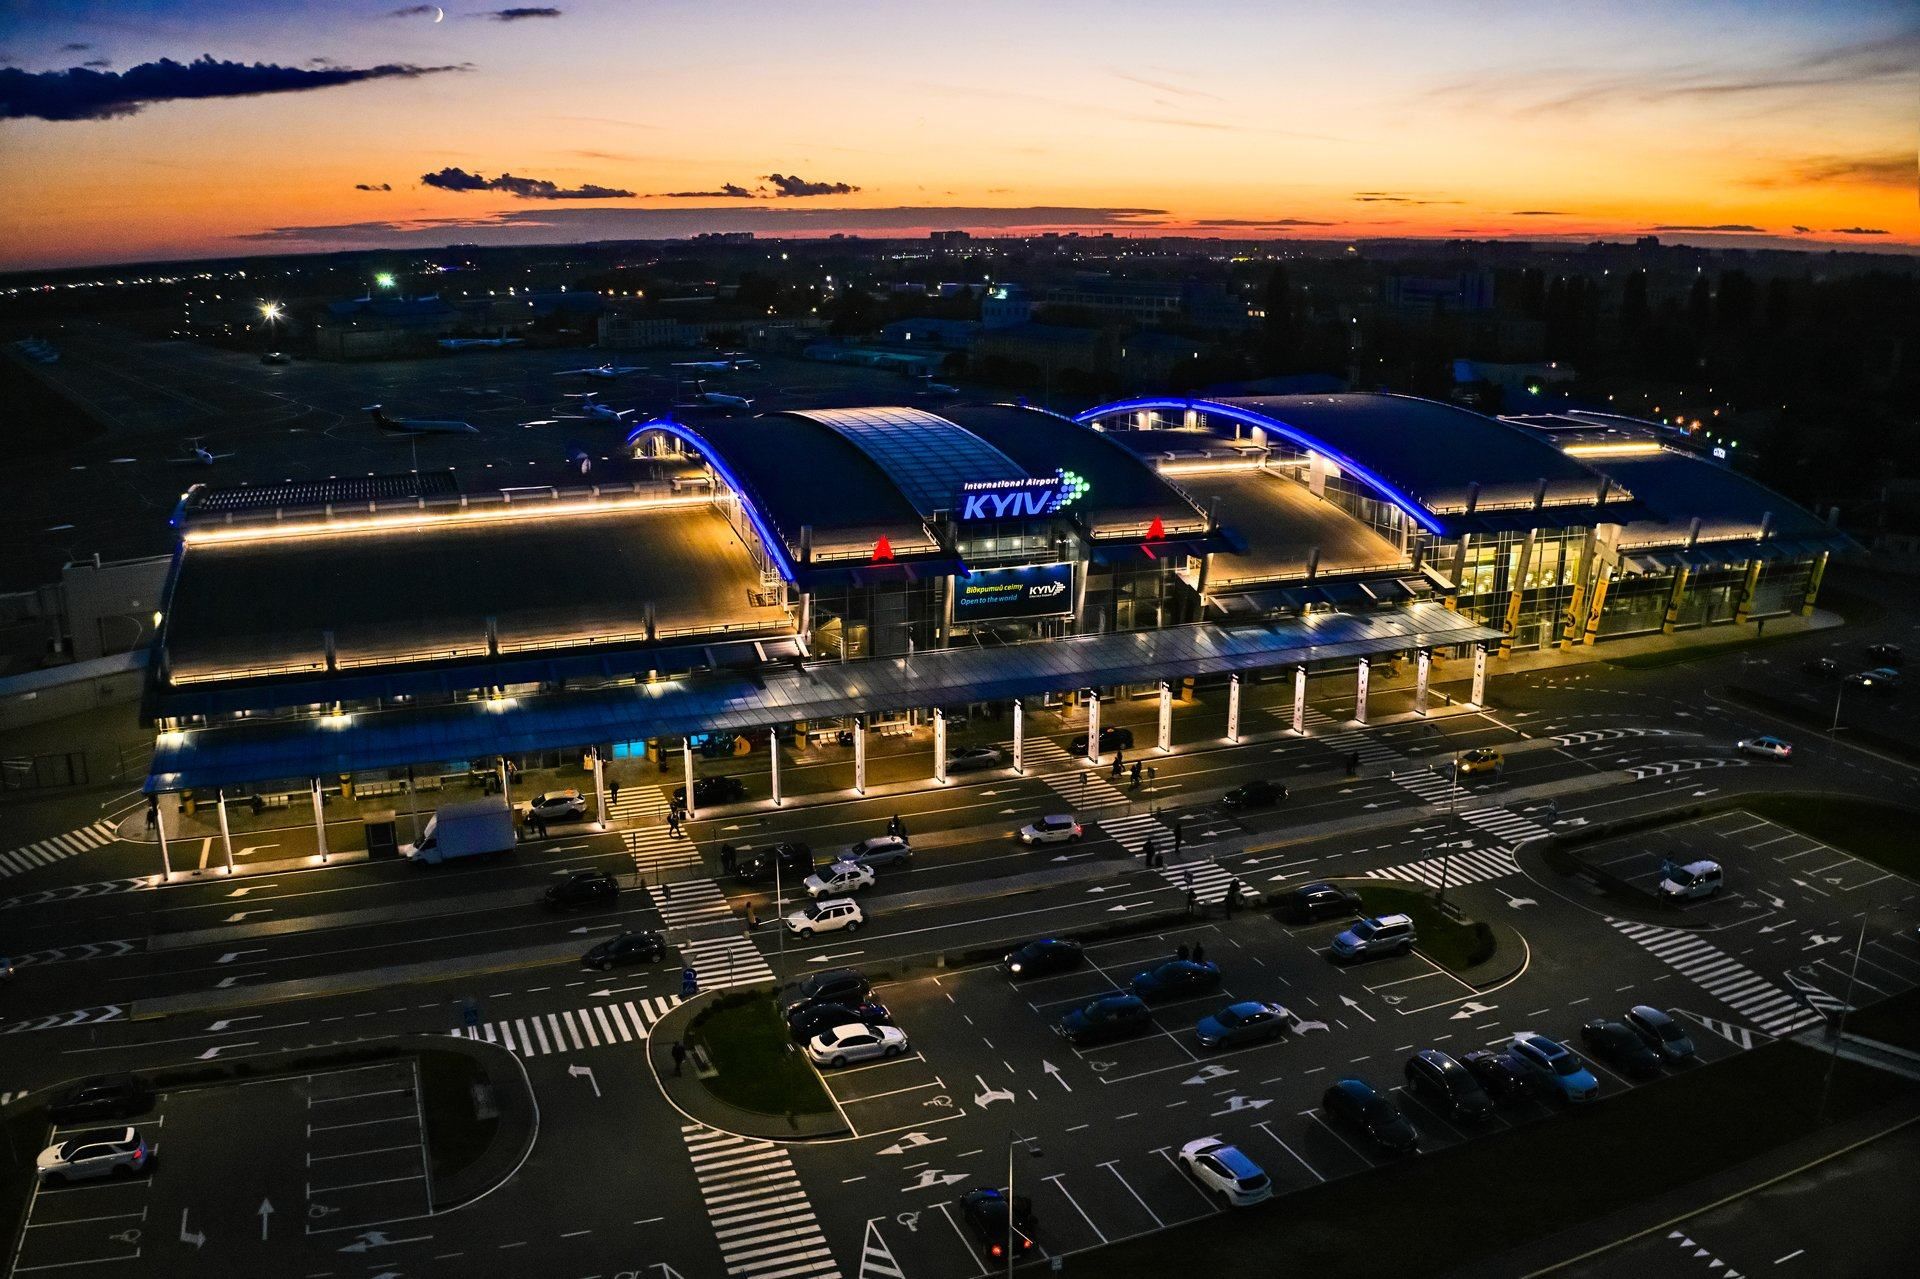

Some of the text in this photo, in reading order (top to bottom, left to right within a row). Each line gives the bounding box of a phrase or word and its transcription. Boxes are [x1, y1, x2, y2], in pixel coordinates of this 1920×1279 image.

[964, 478, 1058, 490] International Airport
[963, 490, 1052, 519] KYIV
[1029, 585, 1056, 595] KYIV
[960, 598, 979, 606] Open
[998, 594, 1017, 602] world
